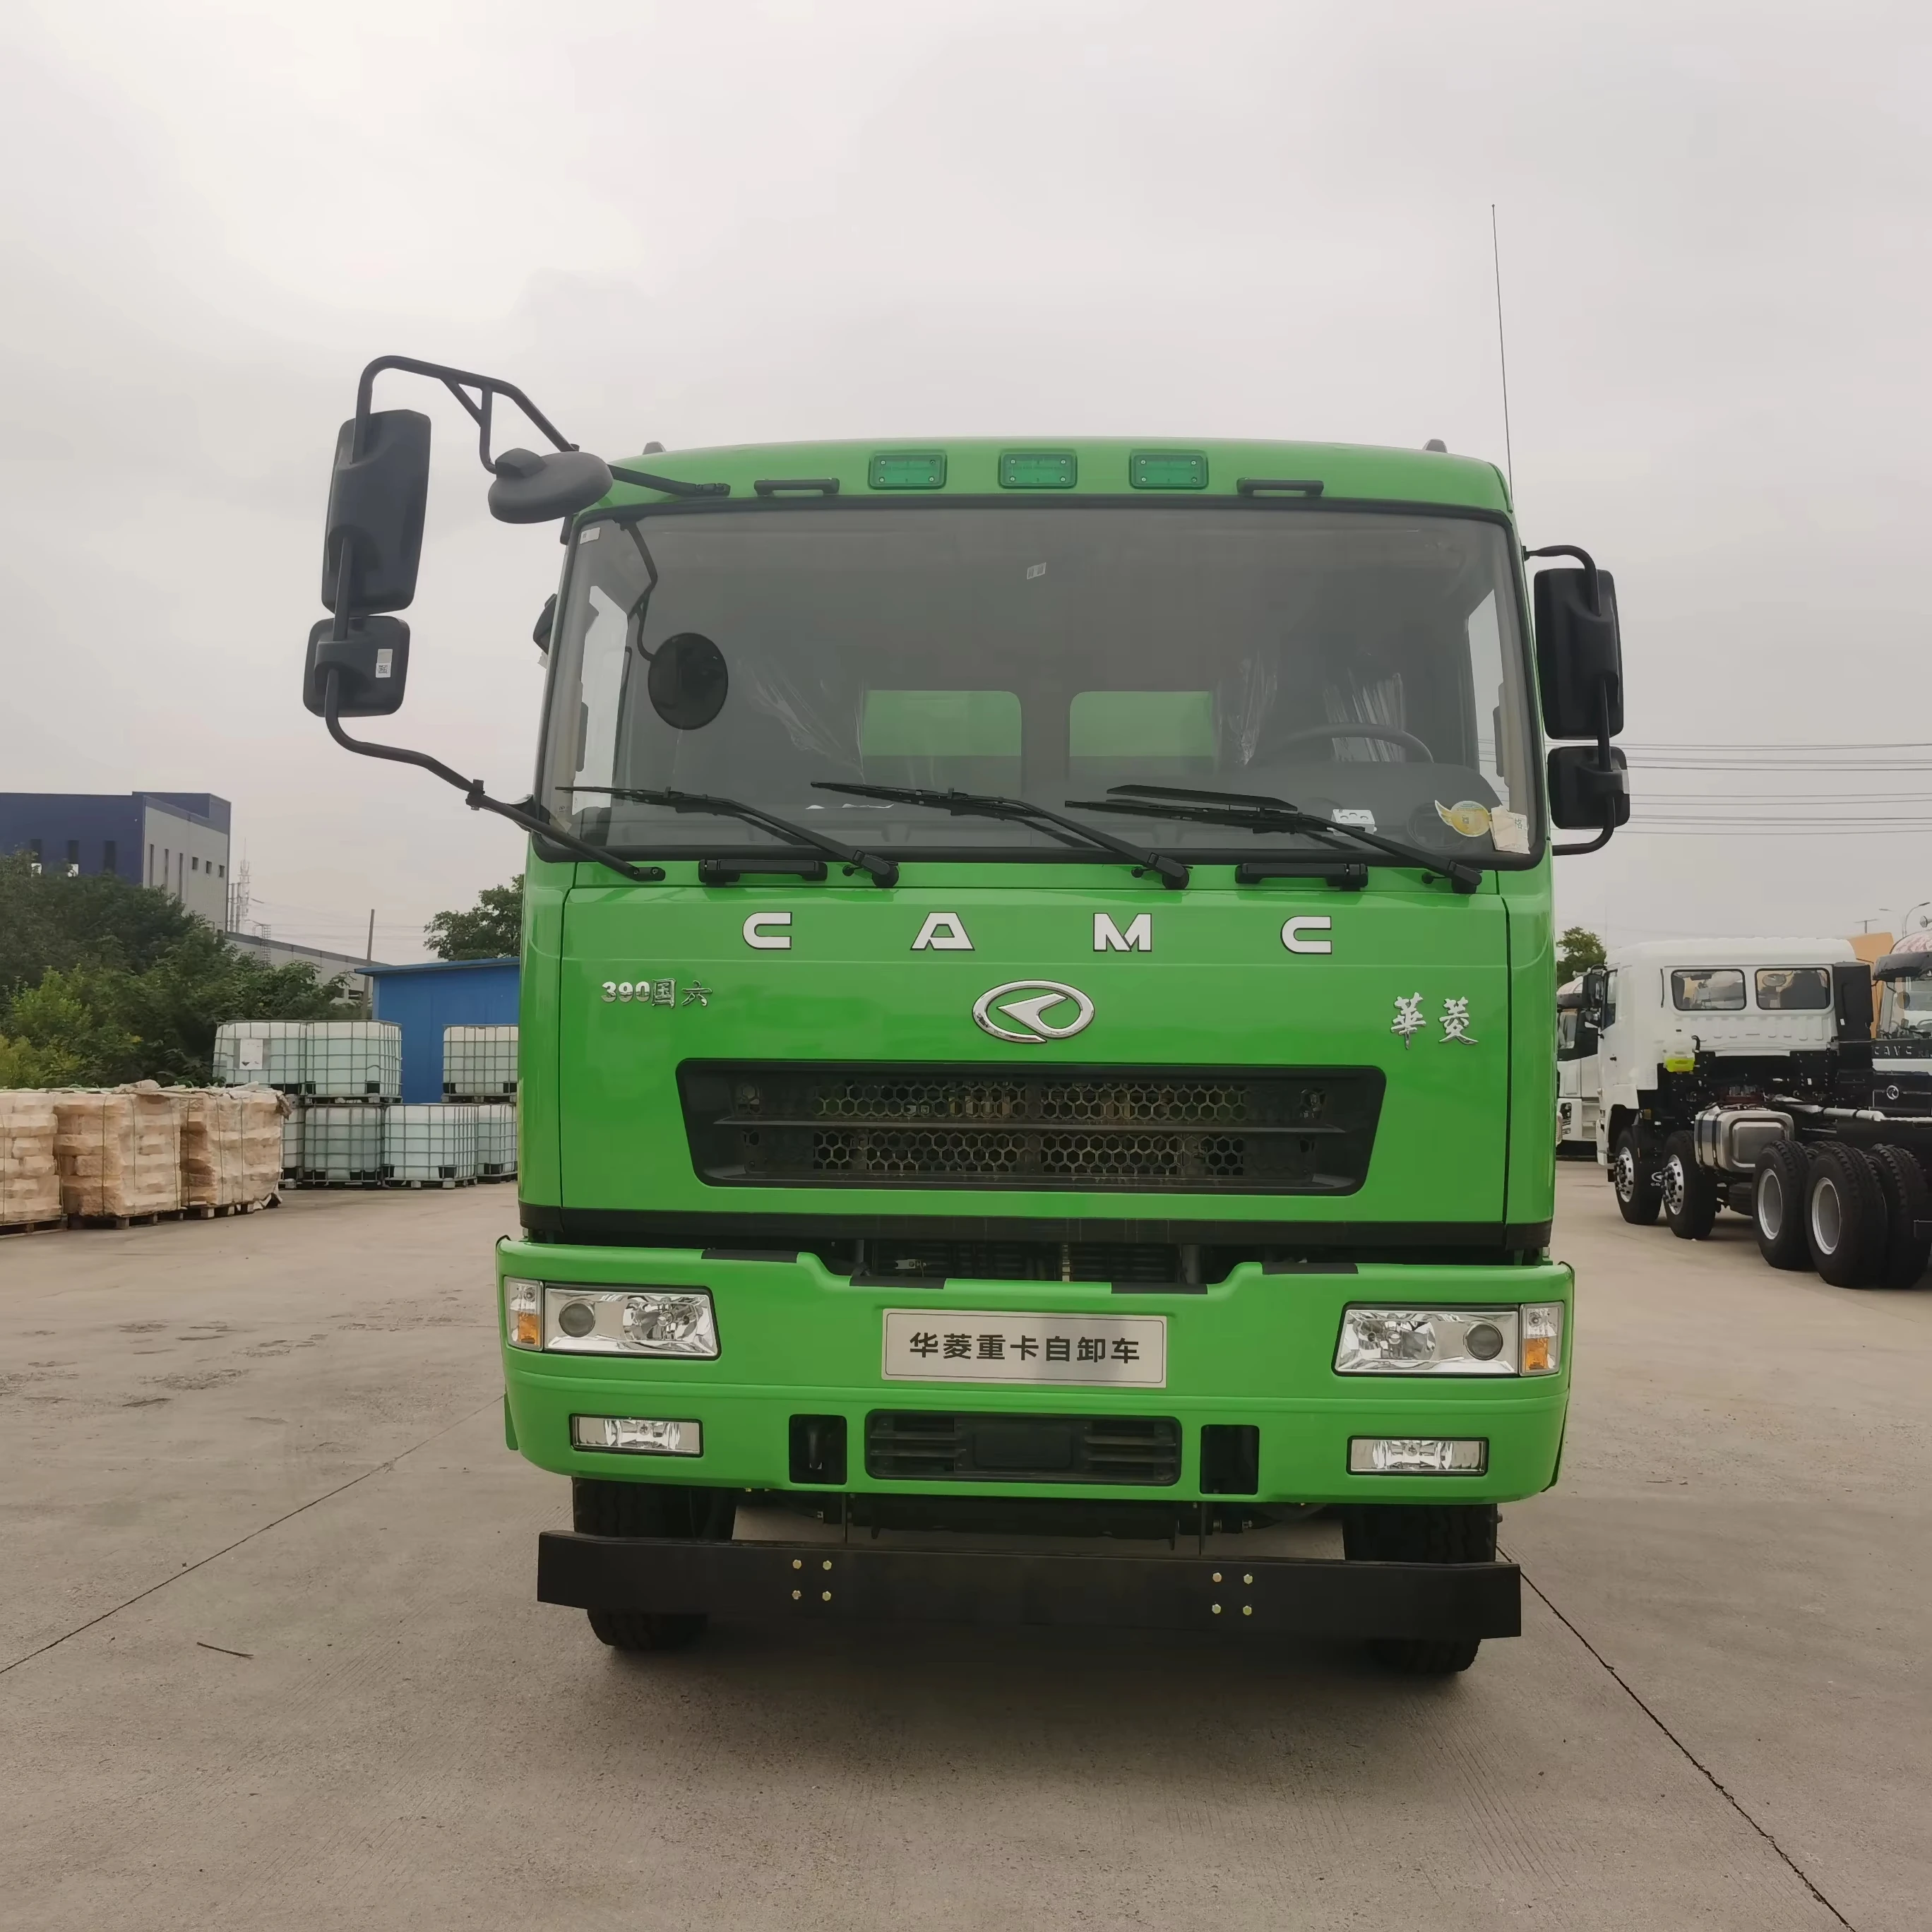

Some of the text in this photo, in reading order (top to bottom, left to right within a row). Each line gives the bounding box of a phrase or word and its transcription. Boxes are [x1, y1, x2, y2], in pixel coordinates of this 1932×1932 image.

[742, 912, 1332, 955] CAMC
[910, 1332, 1140, 1364] 华菱重卡自卸车
